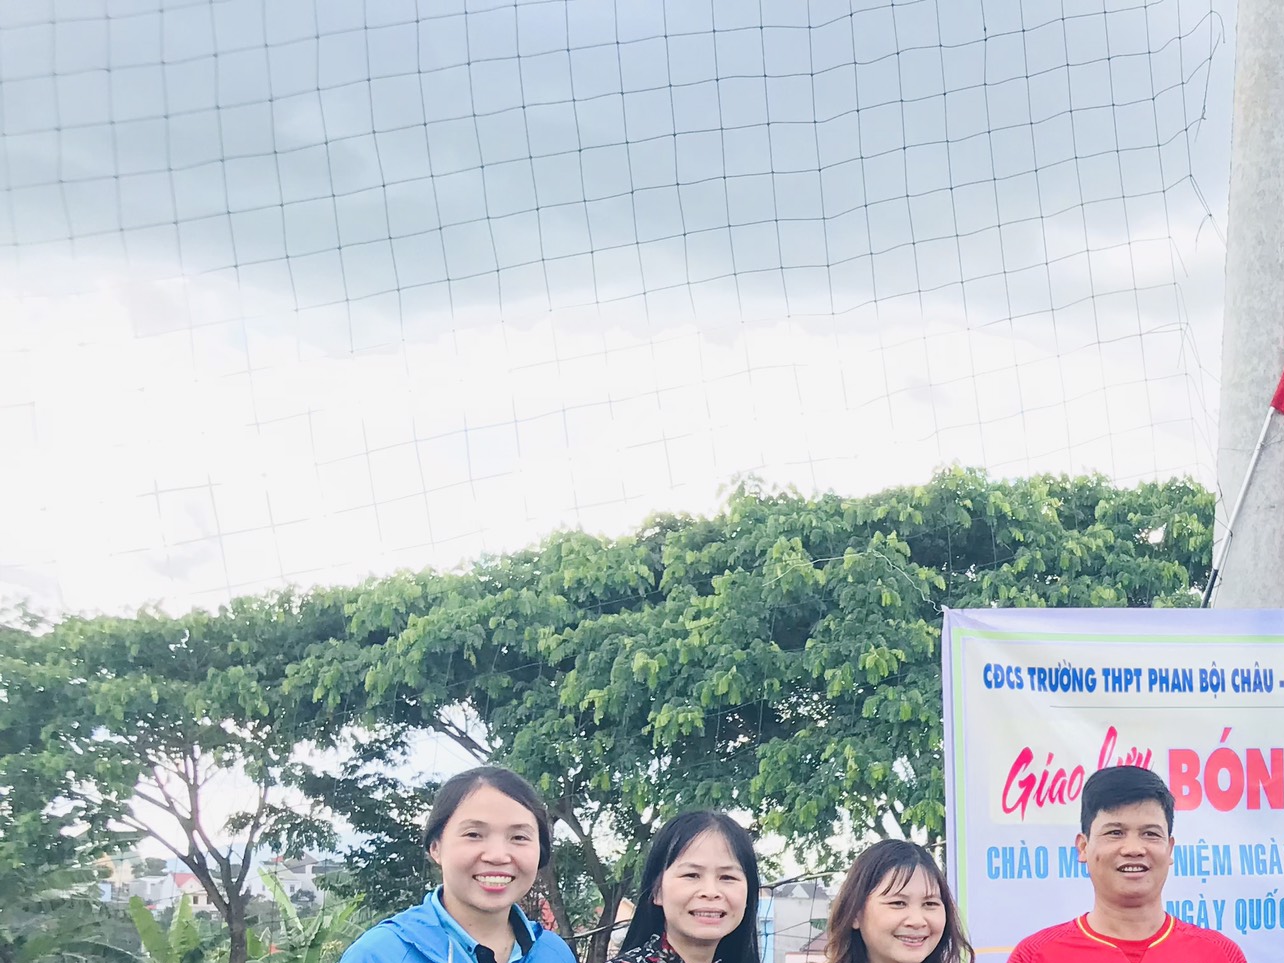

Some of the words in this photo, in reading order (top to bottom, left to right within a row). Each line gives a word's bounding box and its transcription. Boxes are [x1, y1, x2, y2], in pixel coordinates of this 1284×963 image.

[983, 663, 1024, 690] CĐCS
[1028, 659, 1096, 692] TRƯỜNG
[1102, 667, 1142, 692] THPT
[1149, 667, 1193, 692] PHAN
[1200, 661, 1226, 698] BỘI
[1231, 661, 1274, 693] CHÂU
[1001, 746, 1086, 821] Giao
[986, 840, 1048, 880] CHÀO
[1174, 838, 1232, 884] NIỆM
[1166, 893, 1226, 931] NGÀY
